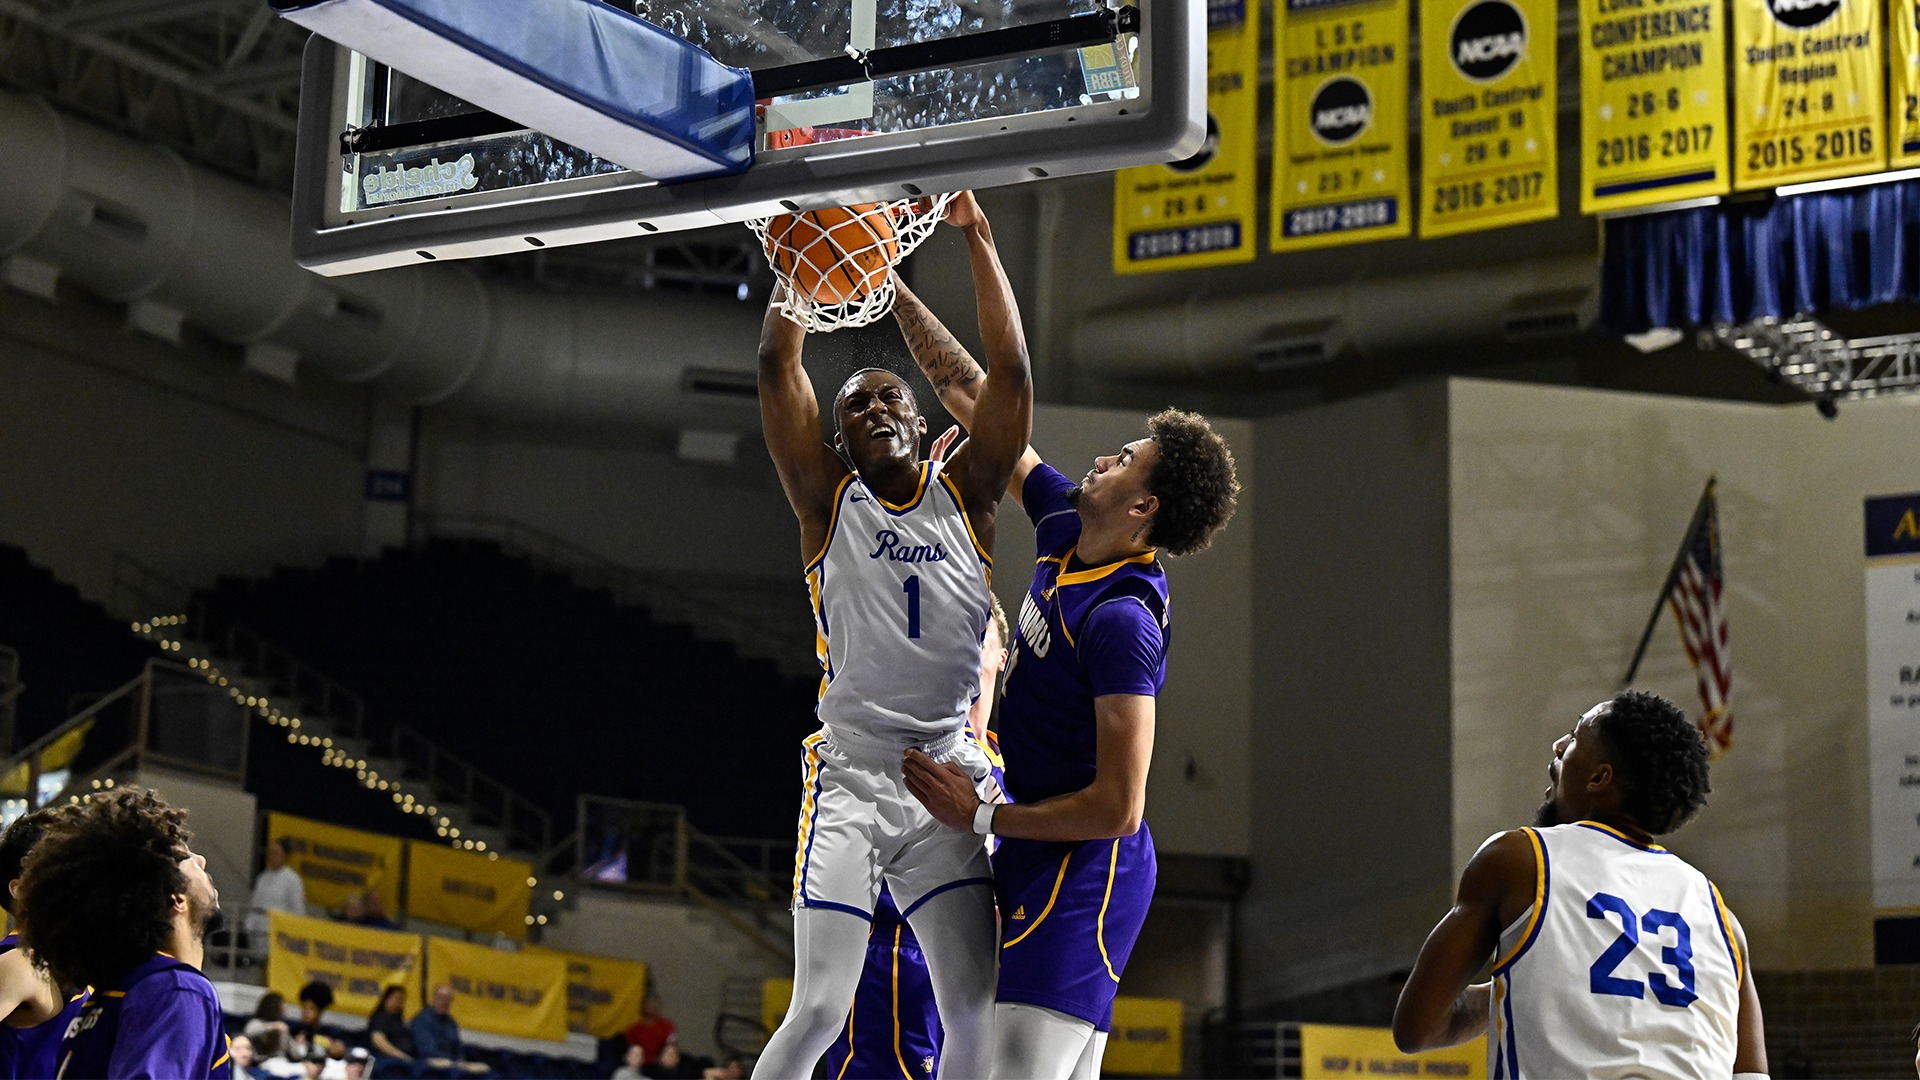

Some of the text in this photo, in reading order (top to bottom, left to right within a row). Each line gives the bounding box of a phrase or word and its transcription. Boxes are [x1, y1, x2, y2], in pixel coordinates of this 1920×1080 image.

[1592, 5, 1710, 49] CONFERENCE
[1802, 30, 1870, 56] Central
[1286, 44, 1394, 79] CHAMPION
[1603, 42, 1702, 82] CHAMPION
[1597, 123, 1713, 167] 2016-2017
[1748, 126, 1872, 170] 2015-2016
[869, 529, 947, 563] Rams
[903, 575, 920, 639] 1
[1586, 892, 1699, 1008] 23
